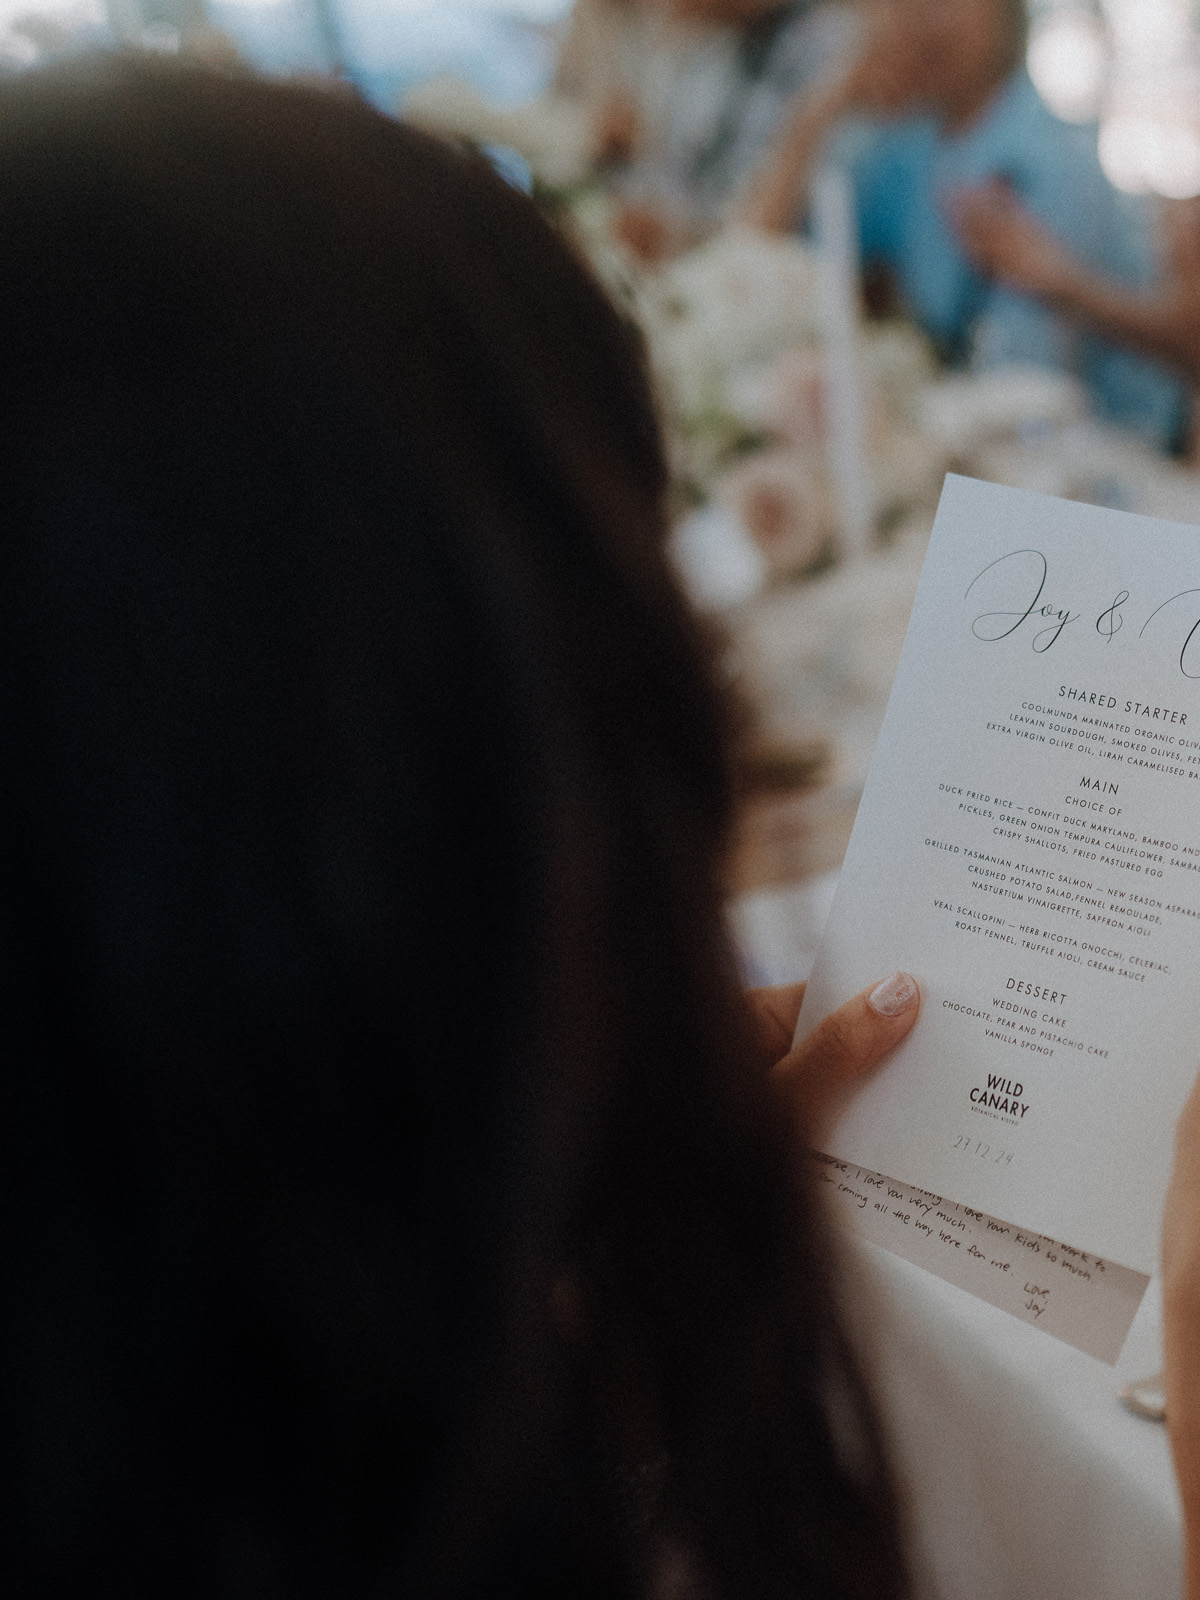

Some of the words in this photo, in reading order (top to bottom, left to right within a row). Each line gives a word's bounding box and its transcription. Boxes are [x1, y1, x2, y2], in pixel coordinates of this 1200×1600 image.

[964, 549, 1082, 654] Joy
[1096, 590, 1131, 645] &
[1021, 701, 1078, 721] COOLMUNDA
[1080, 716, 1131, 734] MARINATED
[1133, 728, 1175, 744] ORGANIC
[1058, 685, 1117, 709] SHARED
[1123, 700, 1188, 726] STARTER
[986, 722, 1012, 734] EXTRA
[1015, 729, 1046, 743] VIRGIN
[1048, 737, 1074, 750] OLIVE
[1077, 744, 1095, 756] OIL,
[1098, 749, 1124, 762] LIRAH
[1126, 756, 1185, 776] CARAMELISED
[1009, 713, 1046, 728] LEAVAIN
[1048, 722, 1107, 744] SOURDOUGH,
[1110, 737, 1147, 753] SMOKED
[1150, 746, 1183, 762] OLIVES,
[1064, 795, 1105, 813] CHOICE
[1108, 806, 1122, 816] OF
[1079, 776, 1119, 795] MAIN
[938, 782, 963, 795] DUCK
[965, 790, 991, 803] FRIED
[993, 797, 1013, 809] RICE
[1027, 806, 1061, 821] CONFIT
[1062, 815, 1087, 828] DUCK
[1089, 822, 1138, 842] MARYLAND,
[1141, 835, 1179, 851] BAMBOO
[1181, 846, 1200, 857] AND
[958, 802, 995, 820] PICKLES,
[998, 813, 1027, 827] GREEN
[1030, 821, 1061, 836] ONION
[1063, 830, 1101, 847] TEMPURA
[1104, 841, 1165, 864] CAULIFLOWER,
[924, 838, 960, 854] GRILLED
[963, 848, 1012, 868] TASMANIAN
[1014, 863, 1055, 880] ATLANTIC
[1057, 874, 1093, 890] SALMON
[1107, 887, 1126, 898] NEW
[1128, 893, 1163, 909] SEASON
[992, 826, 1022, 840] CRISPY
[1024, 835, 1069, 855] SHALLOTS,
[1072, 848, 1097, 861] FRIED
[1099, 855, 1142, 872] PASTURED
[1144, 866, 1163, 878] EGG
[967, 864, 1007, 881] CRUSHED
[1009, 875, 1043, 892] POTATO
[1109, 903, 1162, 925] REMOULADE,
[971, 880, 1024, 901] NASTURTIUM
[1027, 895, 1082, 919] VINAIGRETTE,
[1086, 912, 1125, 929] SAFFRON
[1126, 924, 1151, 937] AIOLI
[933, 899, 953, 912] VEAL
[956, 905, 1006, 926] SCALLOPINI
[1018, 924, 1040, 936] HERB
[1042, 930, 1078, 947] RICOTTA
[1080, 941, 1124, 961] GNOCCHI,
[954, 920, 982, 934] ROAST
[983, 928, 1017, 946] FENNEL,
[1021, 939, 1055, 956] TRUFFLE
[1056, 951, 1083, 965] AIOLI,
[1086, 959, 1115, 973] CREAM
[1117, 968, 1146, 982] SAUCE
[992, 997, 1038, 1019] WEDDING
[1041, 1013, 1067, 1028] CAKE
[1005, 977, 1067, 1005] DESSERT
[942, 999, 993, 1023] CHOCOLATE,
[996, 1016, 1016, 1029] PEAR
[1018, 1024, 1037, 1036] AND
[1039, 1030, 1084, 1051] PISTACHIO
[1087, 1045, 1109, 1059] CAKE
[984, 1028, 1017, 1045] VANILLA
[1020, 1039, 1054, 1057] SPONGE
[969, 1087, 1030, 1118] CANARY
[987, 1073, 1024, 1097] WILD
[838, 1183, 869, 1209] coming
[874, 1203, 888, 1215] all
[892, 1210, 912, 1226] the
[914, 1219, 934, 1237] way
[938, 1230, 962, 1249] here
[863, 1174, 885, 1189] love
[909, 1197, 933, 1216] very
[1045, 1251, 1058, 1264] so
[1024, 1299, 1046, 1320] Joy
